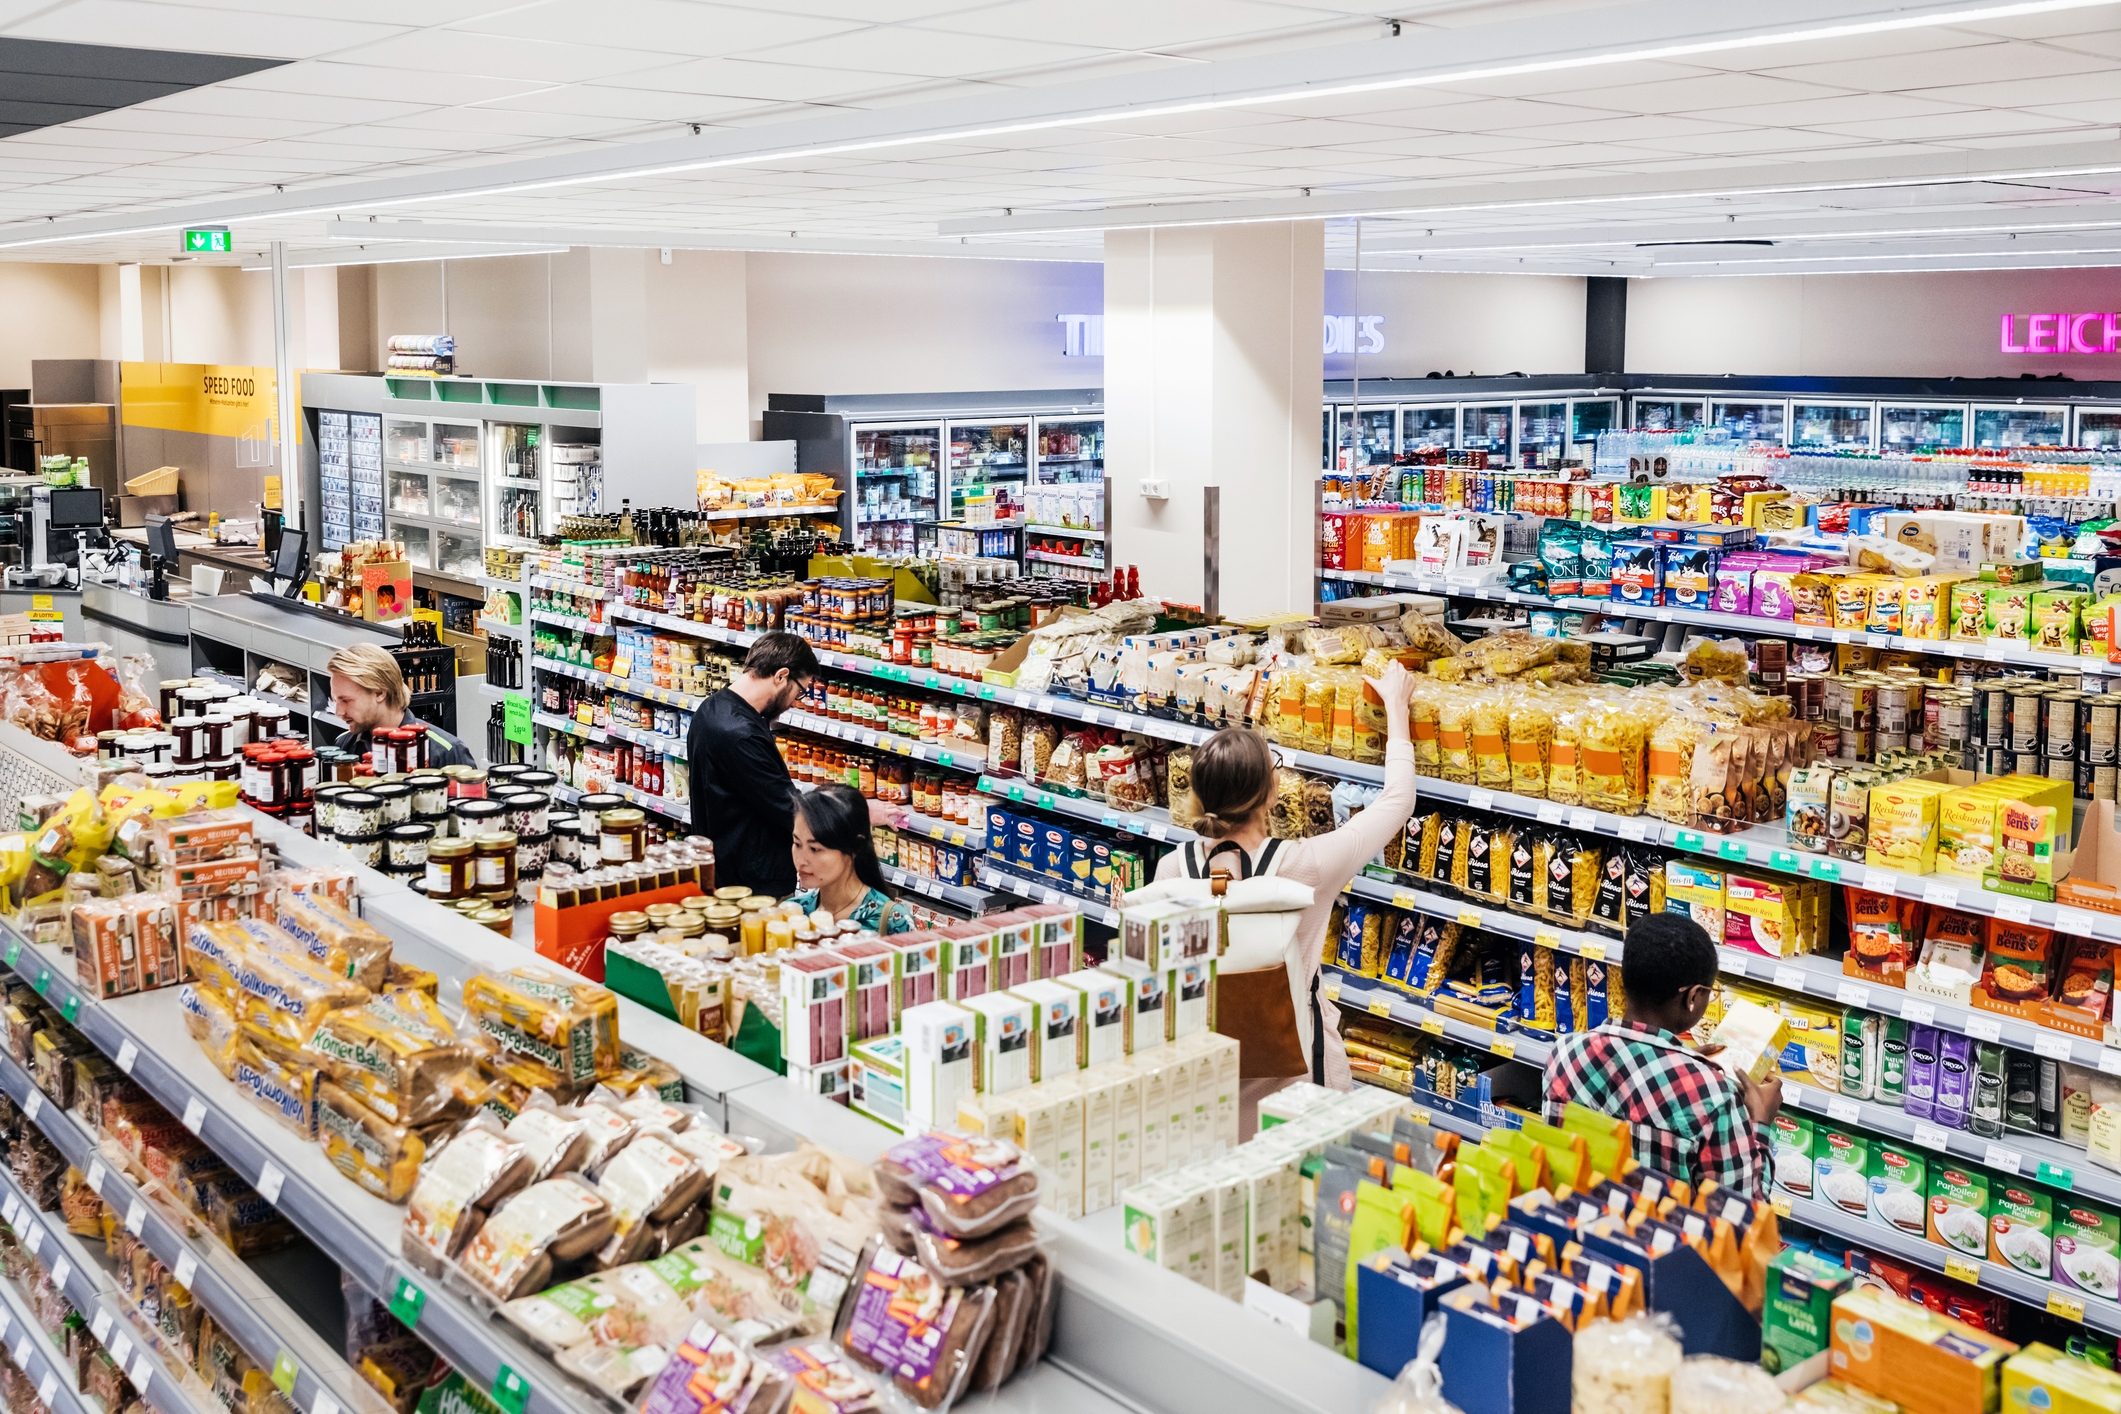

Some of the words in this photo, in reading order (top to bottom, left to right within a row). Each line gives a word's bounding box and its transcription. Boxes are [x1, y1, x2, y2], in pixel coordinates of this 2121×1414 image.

[203, 376, 229, 395] SPEED
[231, 378, 255, 396] FOOD
[1872, 802, 1918, 819] Reiskugeln
[2010, 809, 2028, 820] Uncle
[1943, 808, 1991, 826] Reiskugeln
[2006, 814, 2029, 831] Ben's
[190, 837, 206, 846] Bio
[208, 829, 240, 839] BROTKORB
[1468, 858, 1488, 868] Riesa
[196, 874, 213, 883] Bio
[214, 866, 247, 877] BROTKORB
[1510, 868, 1531, 879] Riesa
[1548, 881, 1570, 893] Riesa
[1601, 880, 1622, 893] Riesa
[2021, 887, 2045, 897] GRAINS
[1730, 889, 1752, 897] reis-fit
[1626, 898, 1648, 910] Riesa
[1860, 897, 1878, 906] Uncle
[2068, 896, 2114, 911] EXPRESS
[1733, 902, 1773, 917] Basmati-Reis
[1945, 915, 1969, 927] Uncle
[2004, 929, 2027, 942] Uncle
[1996, 934, 2026, 951] Ben's
[1855, 969, 1894, 984] EXPRESS
[1918, 985, 1959, 999] CLASSIC
[1985, 1001, 2028, 1016] EXPRESS
[2050, 1019, 2095, 1036] EXPRESS
[1791, 1033, 1836, 1051] zen-Langkorn
[1884, 1041, 1906, 1051] ORYZA
[1913, 1051, 1934, 1062] ORYZA
[1942, 1058, 1964, 1070] ORYZA
[1978, 1075, 2001, 1085] ORYZA
[1775, 1128, 1796, 1140] Milch
[1779, 1134, 1792, 1143] Reis
[1829, 1145, 1850, 1157] Milch
[1833, 1153, 1846, 1161] Reis
[1884, 1164, 1906, 1176] Milch
[1888, 1172, 1902, 1180] Reis
[1936, 1180, 1978, 1199] Parboiled
[1949, 1190, 1964, 1200] Reis
[1998, 1199, 2041, 1219] Parboiled
[2012, 1210, 2027, 1220] Reis
[2062, 1218, 2109, 1238] Langkorn
[2078, 1231, 2093, 1240] Reis
[1774, 1300, 1814, 1324] MATCHA
[1788, 1315, 1818, 1336] LATTE
